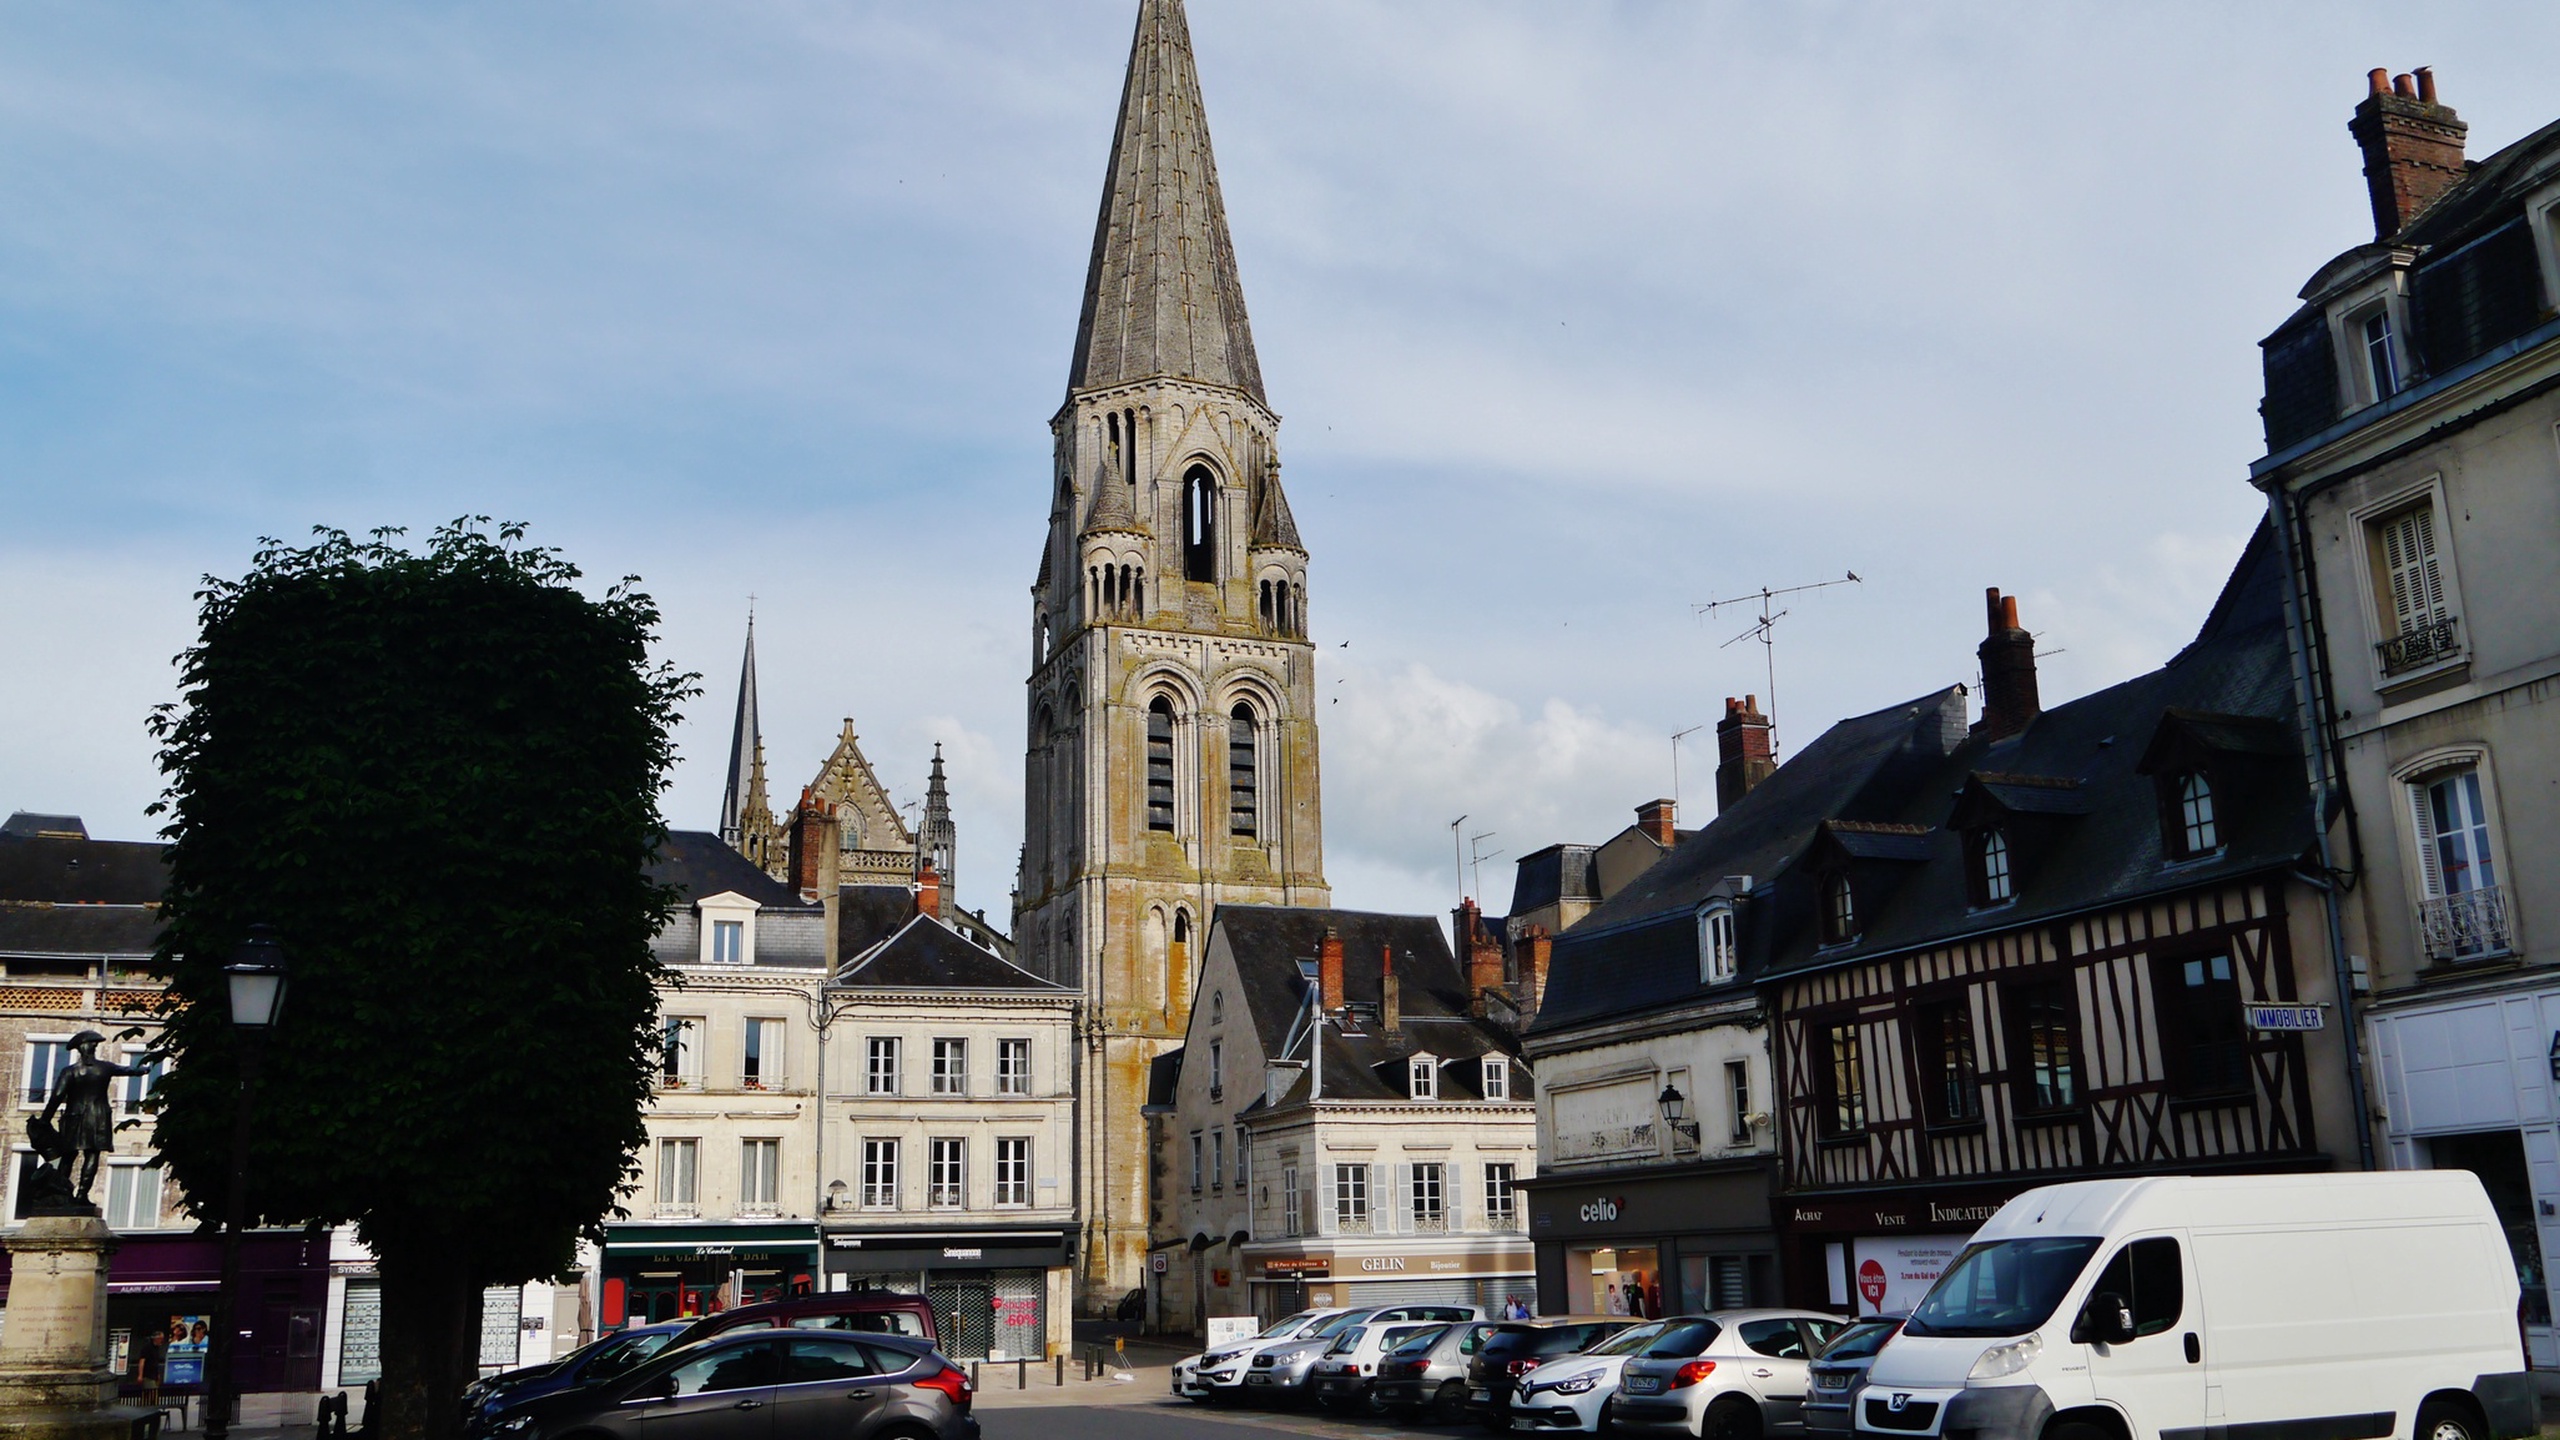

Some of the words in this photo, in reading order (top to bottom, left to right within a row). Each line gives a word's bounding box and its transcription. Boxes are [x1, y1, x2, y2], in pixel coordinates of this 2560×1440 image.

[2254, 1009, 2319, 1027] IMMOBILIER
[1580, 1197, 1617, 1222] celio
[1795, 1208, 1822, 1221] ACHAT
[1875, 1212, 1906, 1226] VENTE
[337, 1265, 372, 1274] SYNDIC
[1361, 1257, 1405, 1271] GELIN
[1867, 1284, 1879, 1297] ICI
[1003, 1312, 1038, 1326] -60%
